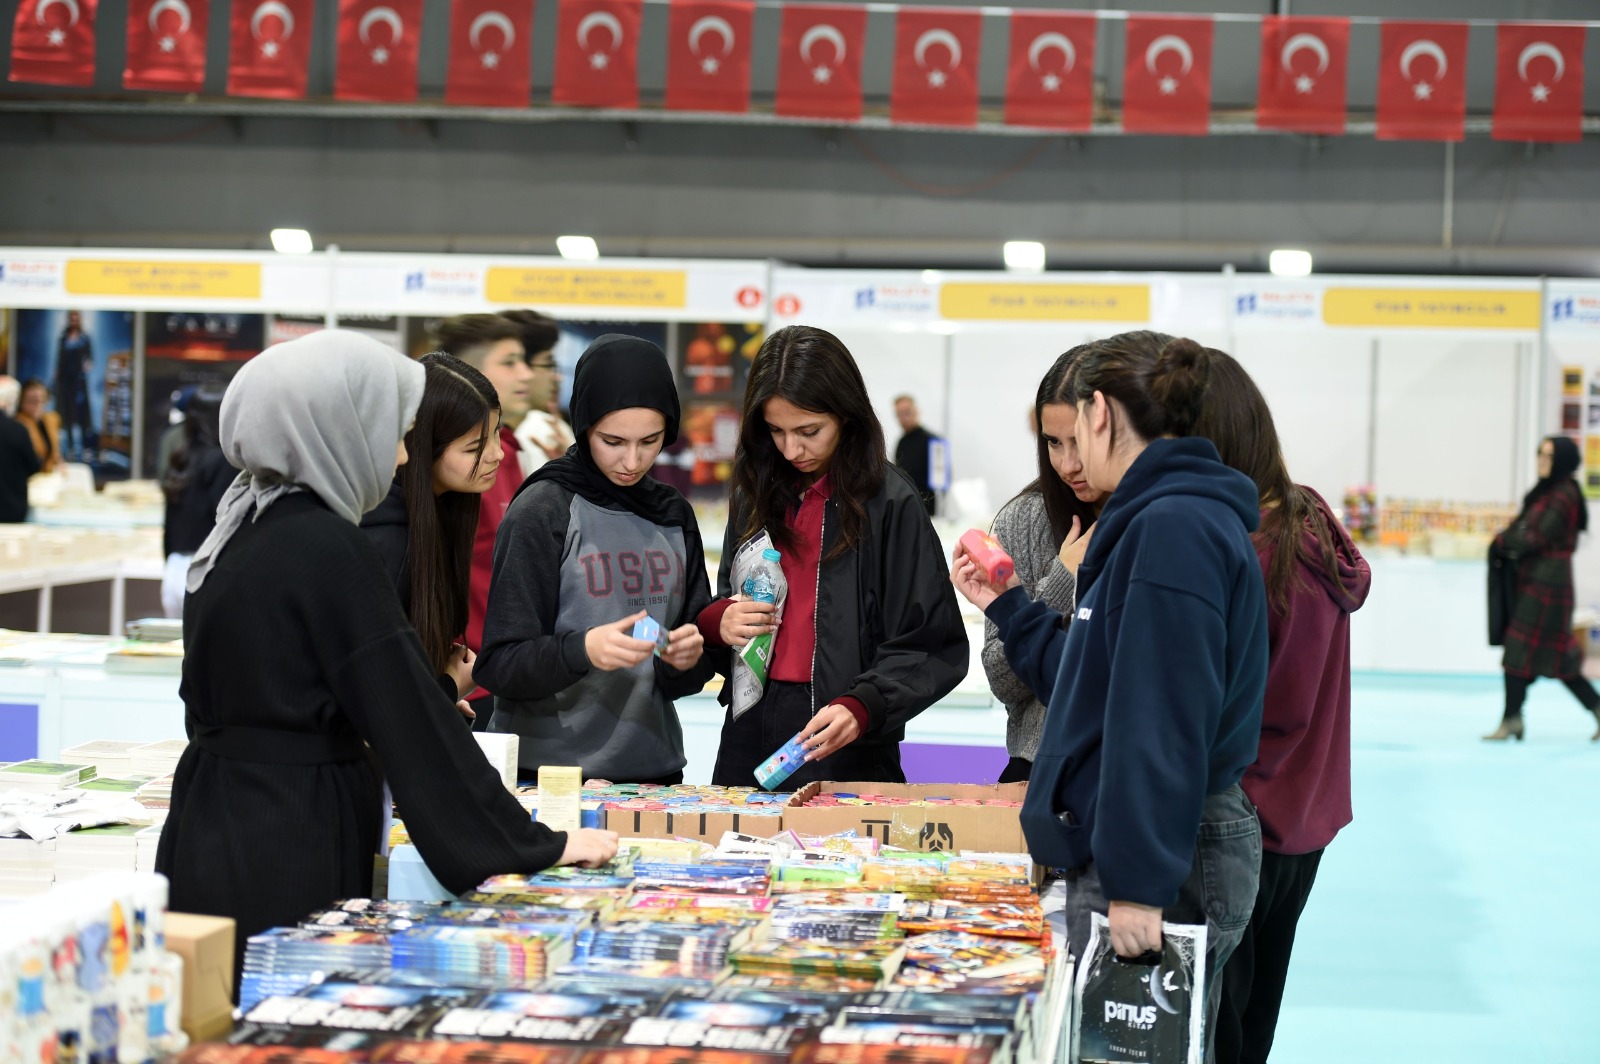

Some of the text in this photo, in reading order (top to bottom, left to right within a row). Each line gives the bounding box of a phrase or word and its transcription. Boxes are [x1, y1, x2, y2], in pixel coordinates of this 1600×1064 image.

[627, 596, 668, 607] SINCE 1890
[1104, 1000, 1157, 1024] pinus
